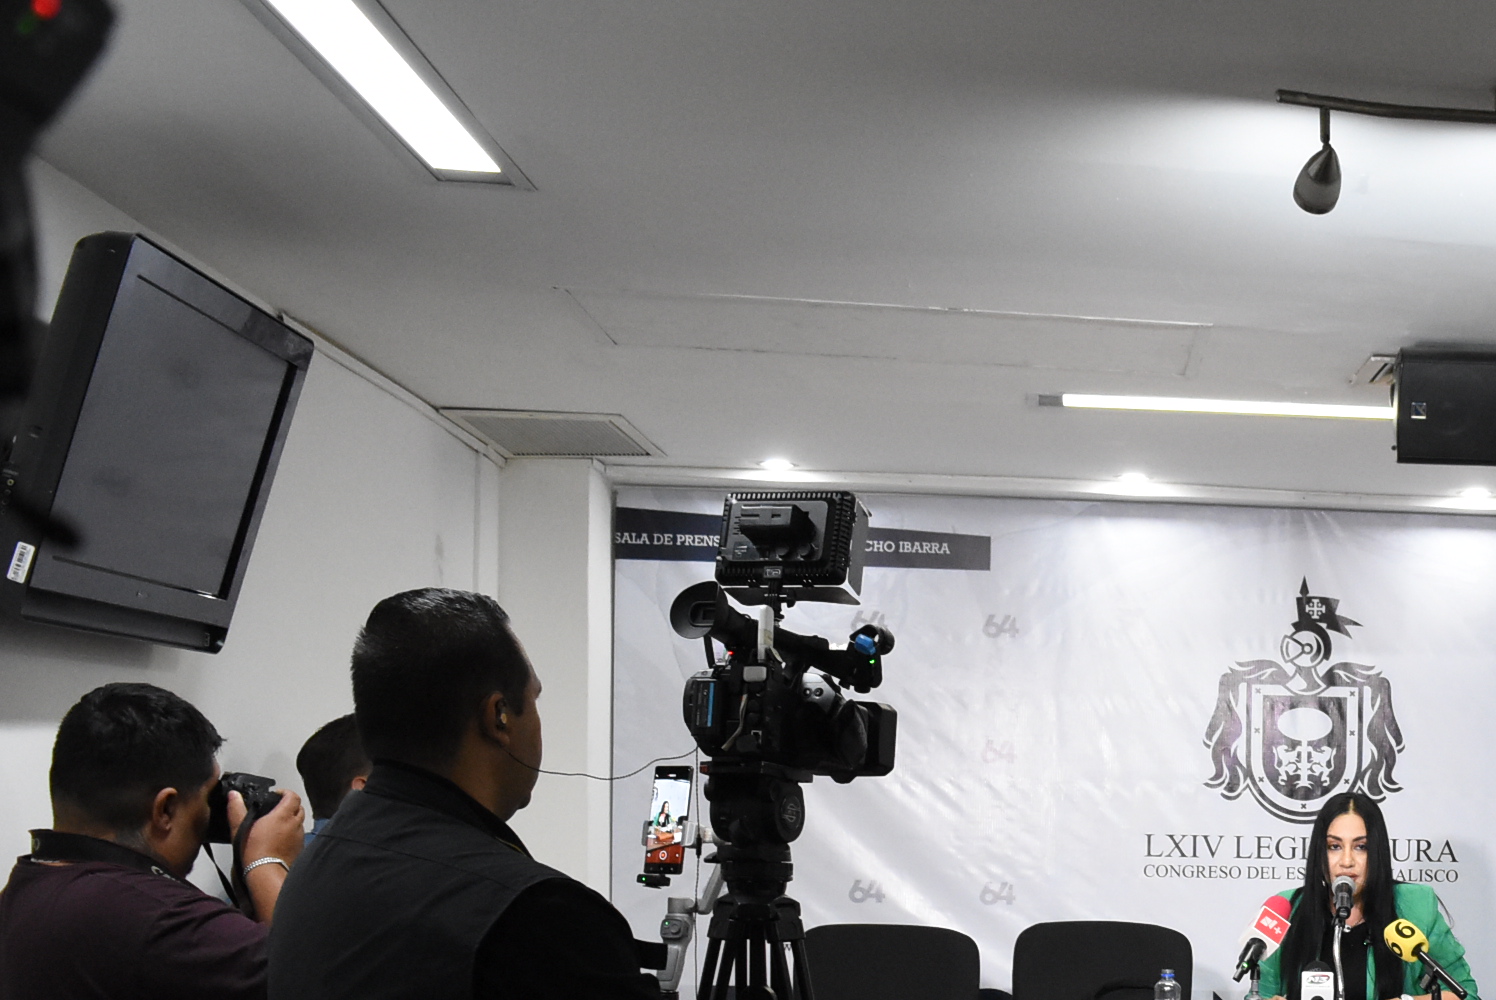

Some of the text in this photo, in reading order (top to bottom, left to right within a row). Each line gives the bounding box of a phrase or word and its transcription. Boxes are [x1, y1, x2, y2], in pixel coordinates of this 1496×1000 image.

[615, 532, 721, 547] SALA DE PRENS
[898, 541, 951, 554] IBARRA
[982, 614, 1019, 638] 64
[1144, 833, 1224, 859] LXIV
[1143, 864, 1241, 879] CONGRESO
[1247, 866, 1281, 880] DEL
[849, 880, 885, 903] 64
[980, 881, 1016, 905] 64
[1395, 921, 1416, 939] 6
